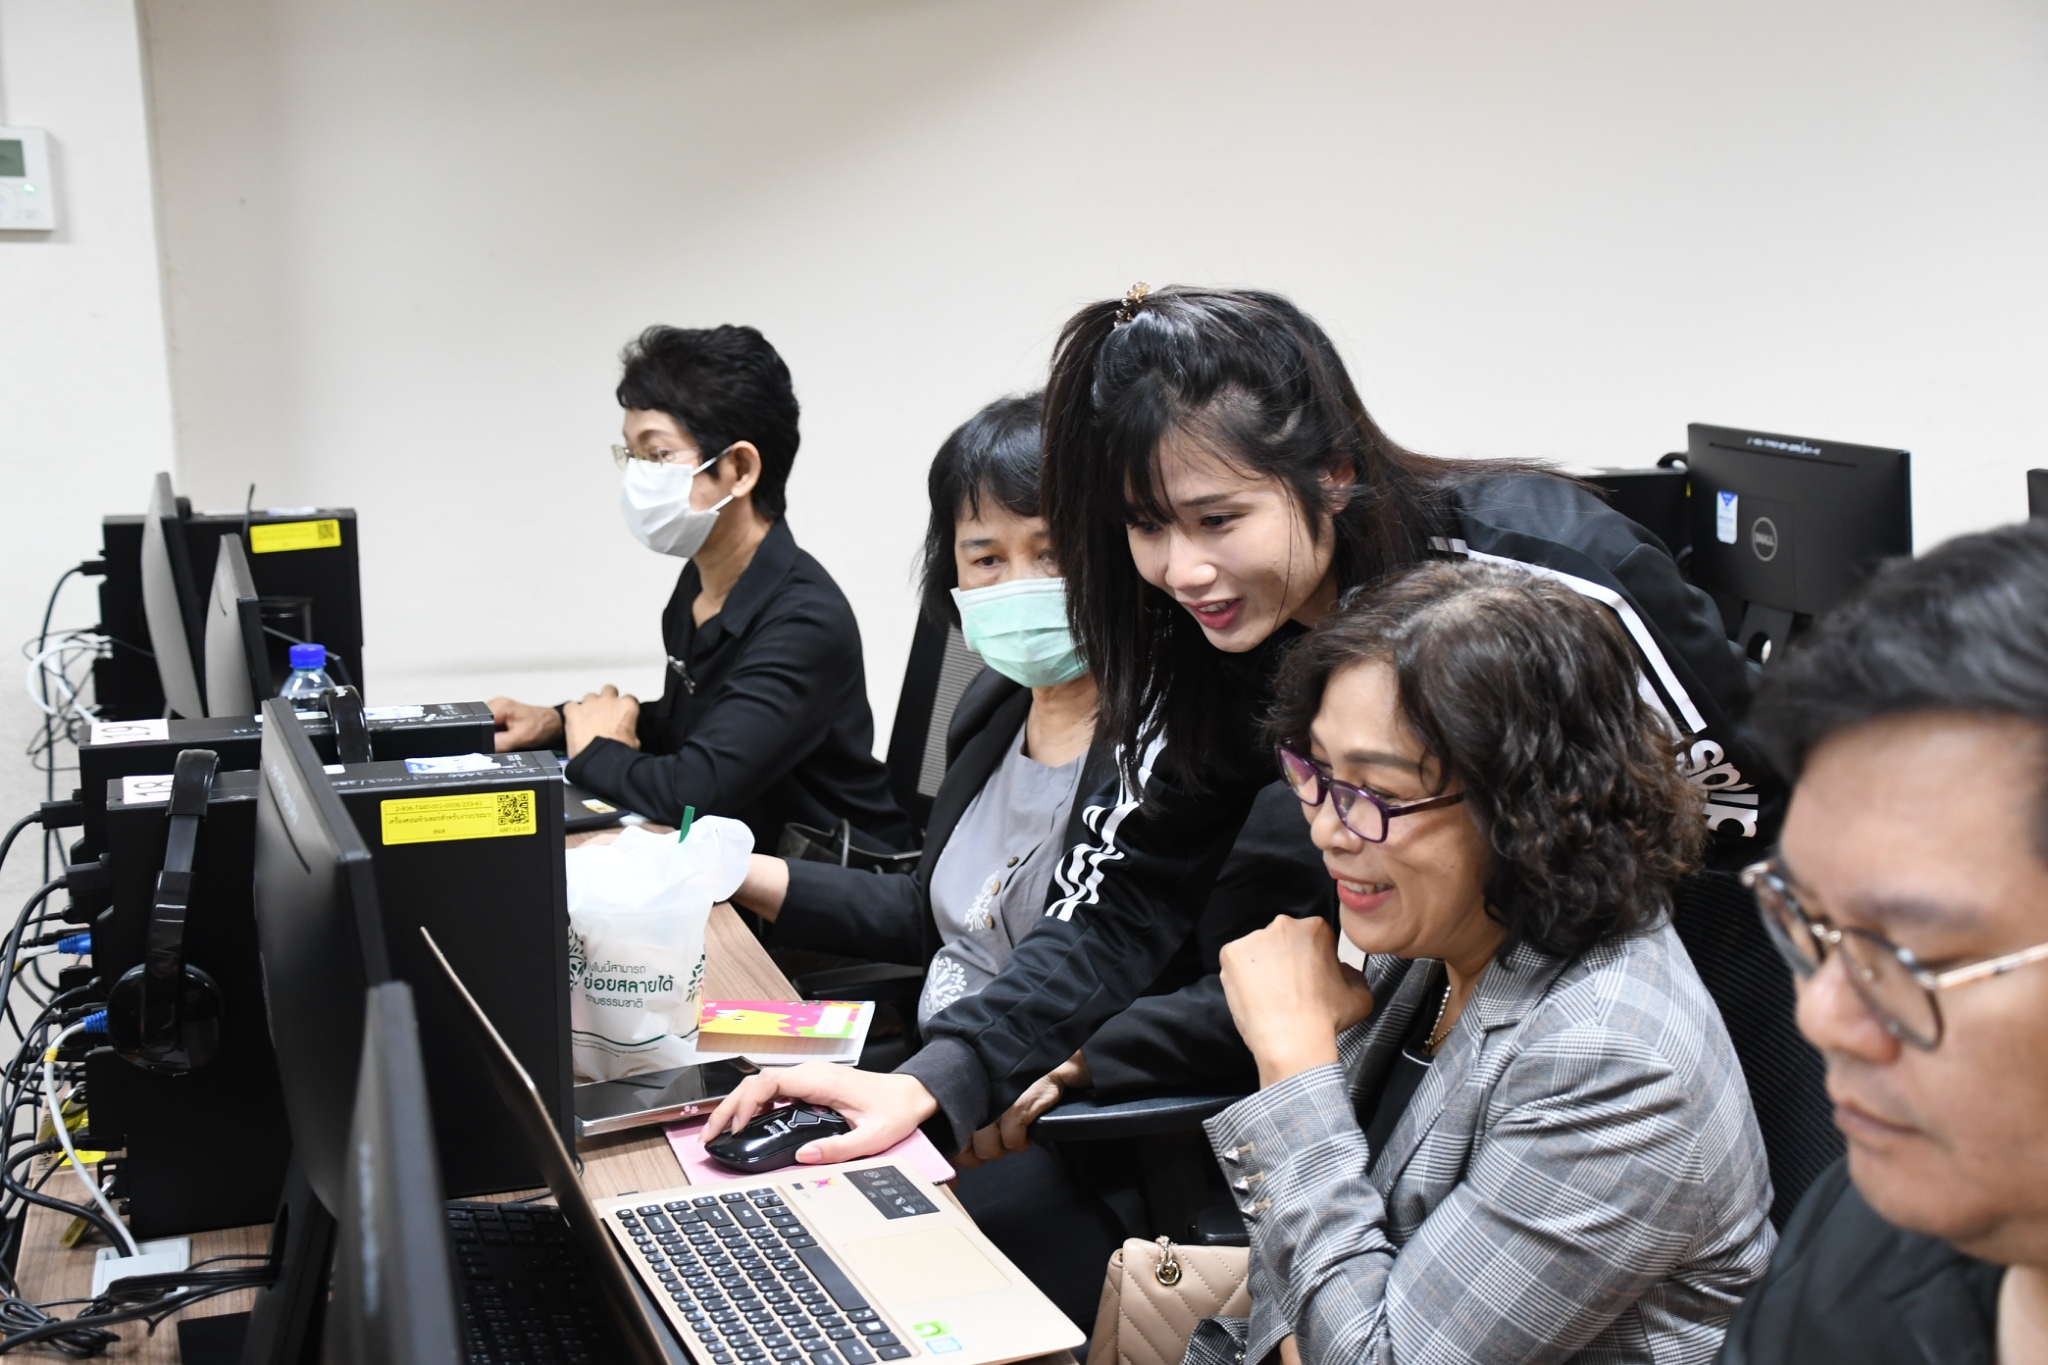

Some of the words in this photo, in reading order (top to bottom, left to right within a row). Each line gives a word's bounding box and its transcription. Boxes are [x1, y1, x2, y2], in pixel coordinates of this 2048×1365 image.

[101, 724, 151, 738] 19
[584, 973, 674, 993] ย่อยสลายได้
